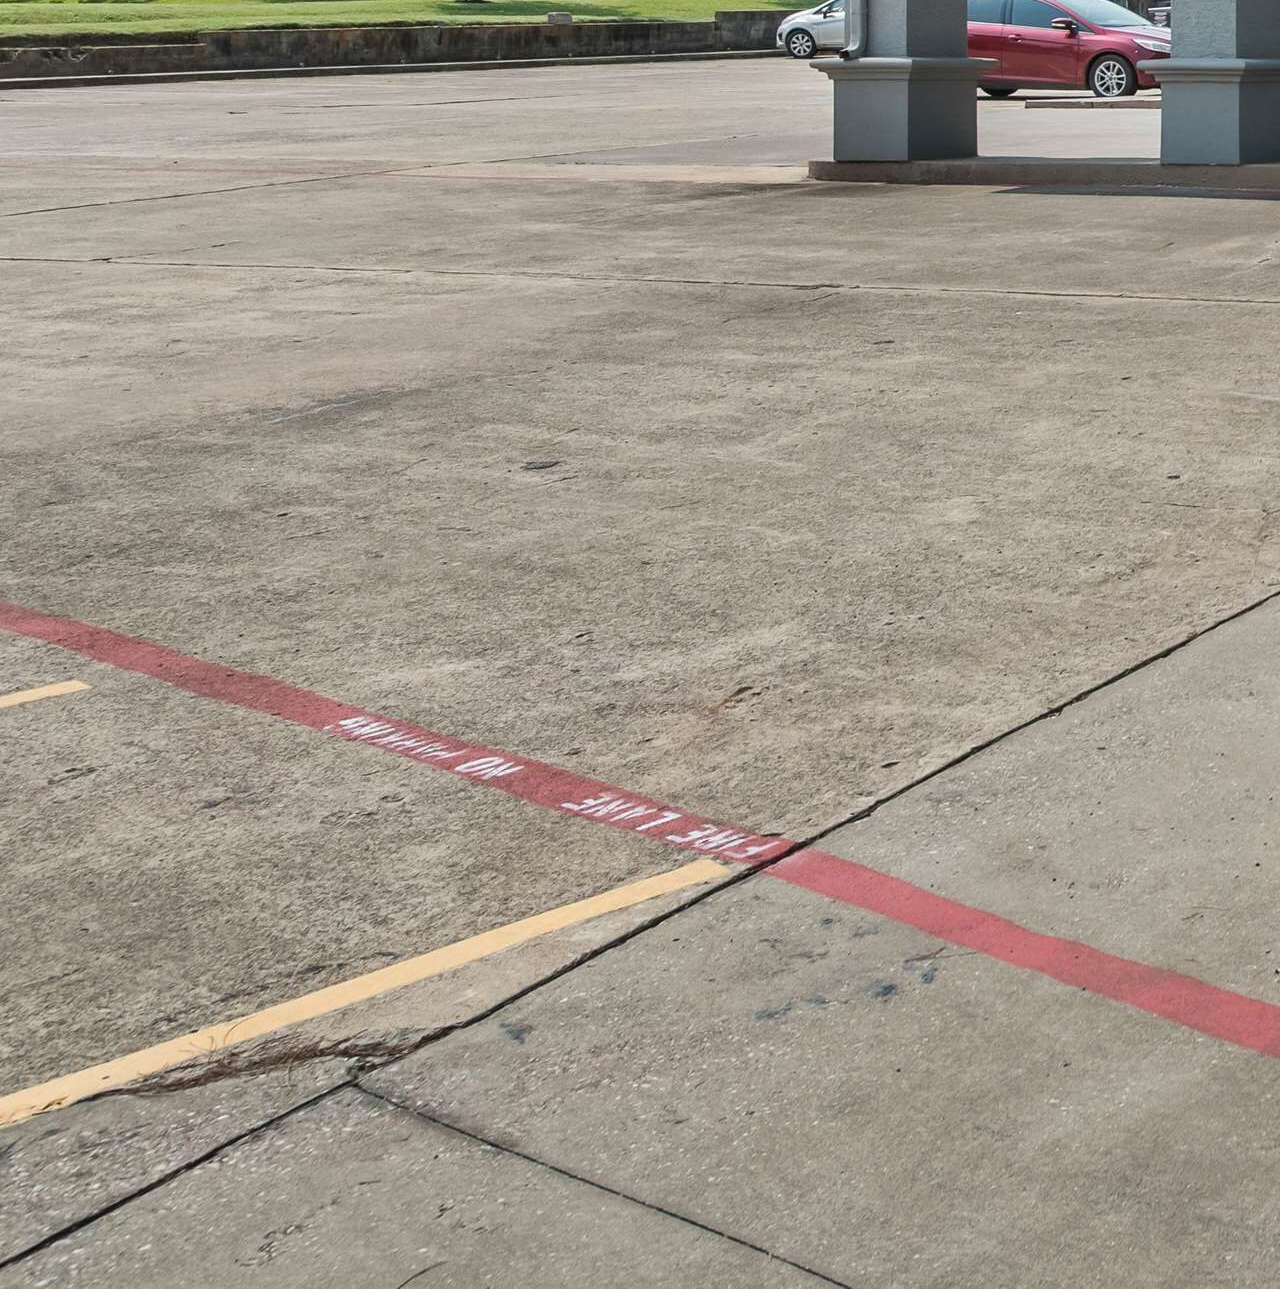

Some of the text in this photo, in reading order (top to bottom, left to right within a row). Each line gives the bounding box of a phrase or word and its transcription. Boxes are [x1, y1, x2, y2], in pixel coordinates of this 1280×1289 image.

[454, 756, 525, 780] NO
[560, 791, 683, 831] LANE
[665, 823, 780, 859] FIRE
